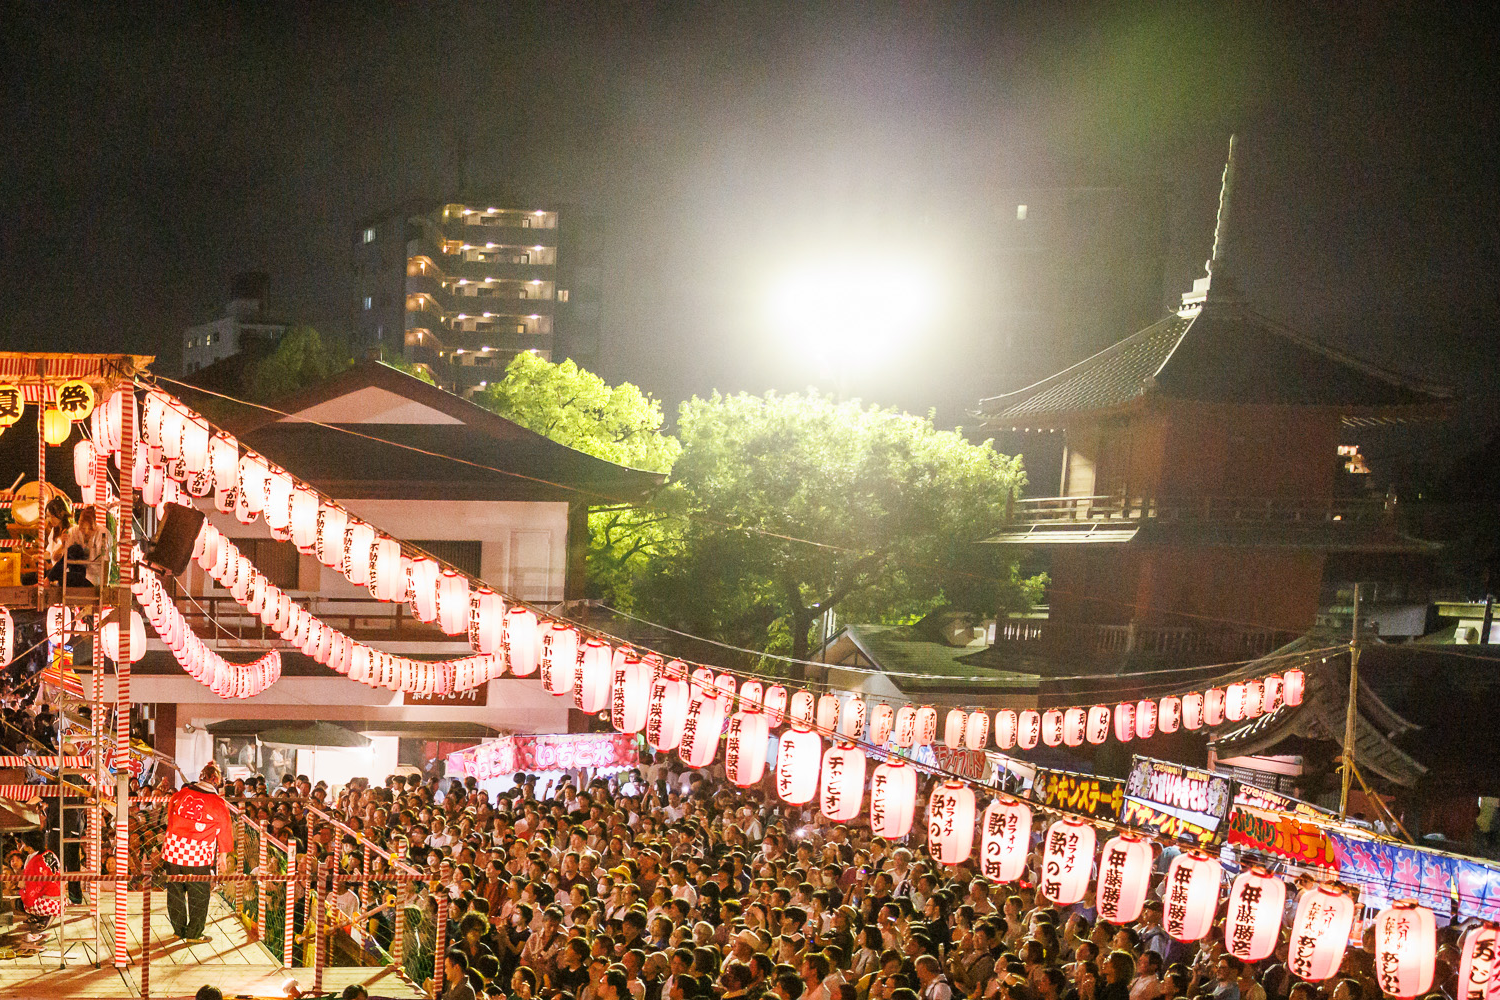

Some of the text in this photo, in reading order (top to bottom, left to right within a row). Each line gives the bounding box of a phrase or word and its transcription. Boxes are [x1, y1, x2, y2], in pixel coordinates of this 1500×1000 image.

[60, 384, 91, 412] 祭
[535, 741, 615, 769] いちご氷
[781, 740, 795, 798] チャンピオン
[826, 756, 844, 816] チャンピオン
[873, 774, 887, 833] チャンピオン
[1046, 774, 1124, 818] チキンステーキ
[943, 796, 957, 837] カラオケ
[1005, 812, 1019, 854] カラオケ
[1064, 832, 1079, 874] カラオケ
